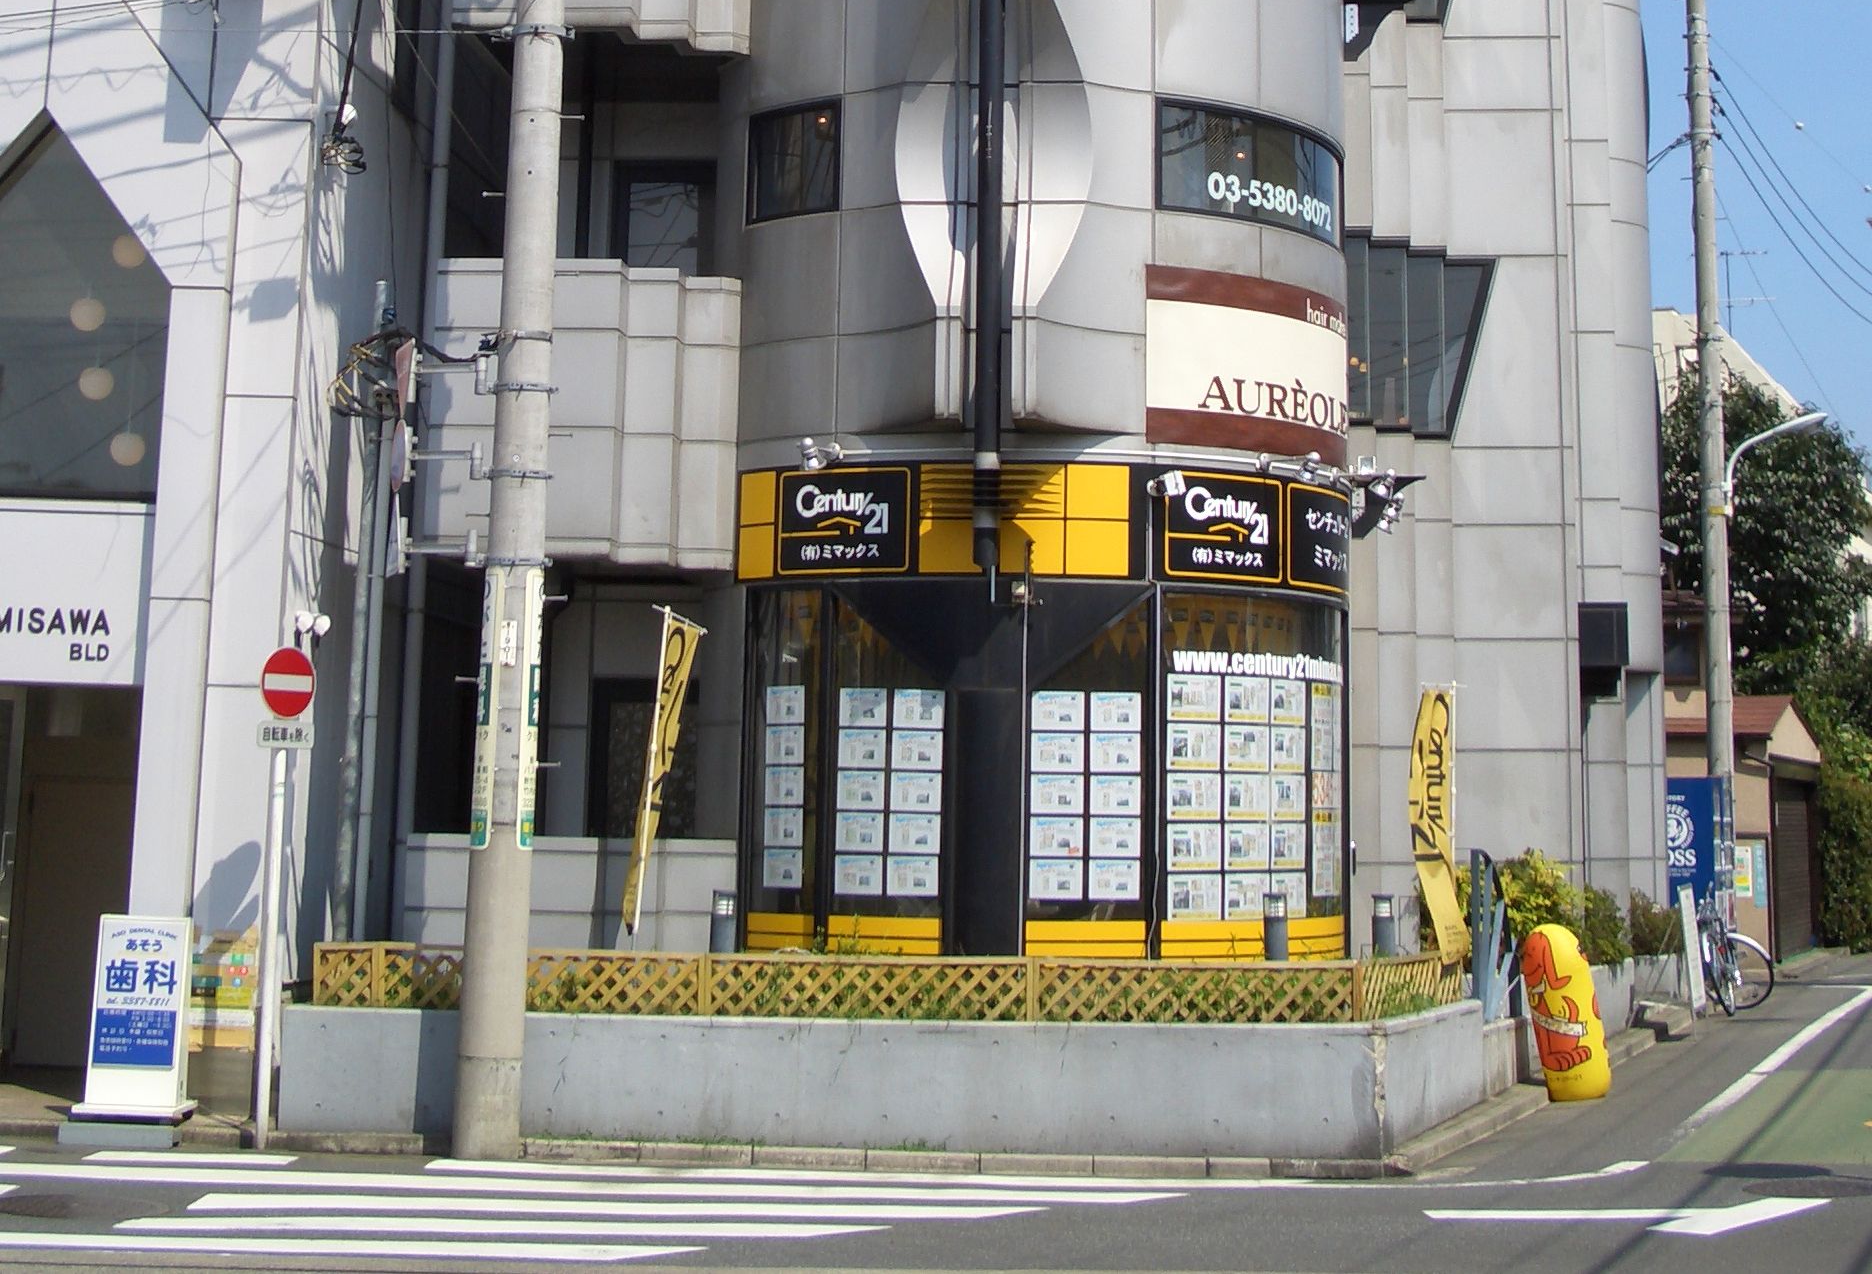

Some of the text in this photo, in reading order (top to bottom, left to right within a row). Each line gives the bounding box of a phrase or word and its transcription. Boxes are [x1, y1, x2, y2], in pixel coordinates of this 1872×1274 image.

[1207, 171, 1332, 232] 03-5380-8072
[1306, 297, 1328, 328] hair
[796, 484, 889, 534] Century 21
[1184, 486, 1269, 545] Century 21
[69, 643, 110, 662] BLD
[126, 938, 163, 953] あそう
[106, 957, 178, 995] 歯科
